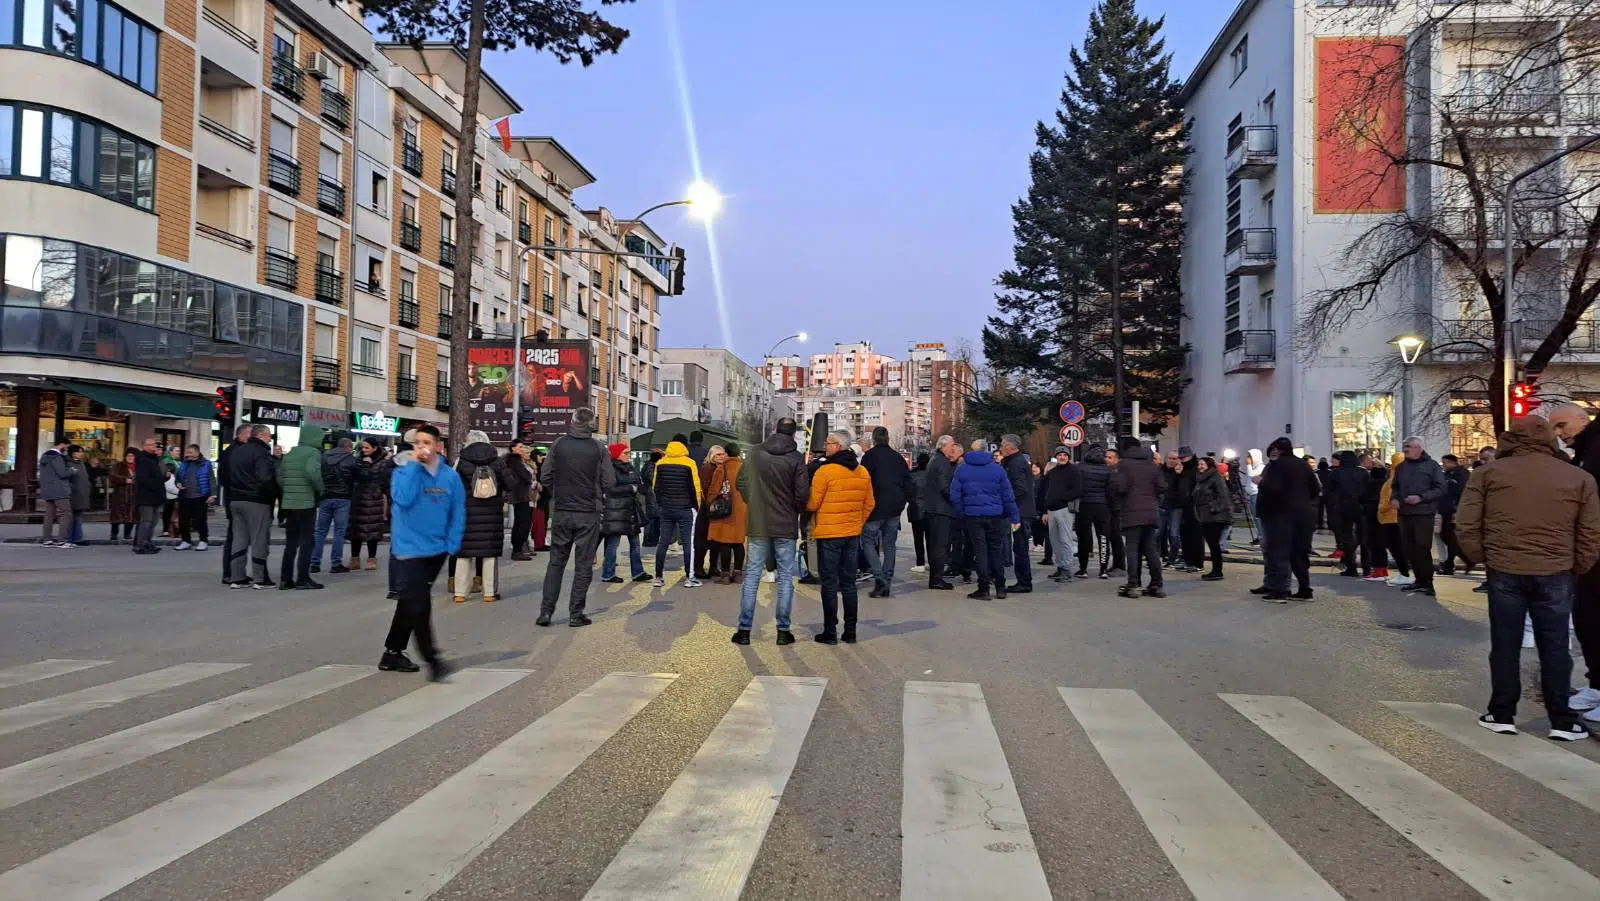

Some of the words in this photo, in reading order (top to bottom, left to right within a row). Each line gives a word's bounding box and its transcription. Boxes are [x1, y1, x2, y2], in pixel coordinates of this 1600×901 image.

[526, 348, 560, 365] 2025
[478, 364, 508, 384] 30
[1064, 430, 1079, 441] 40
